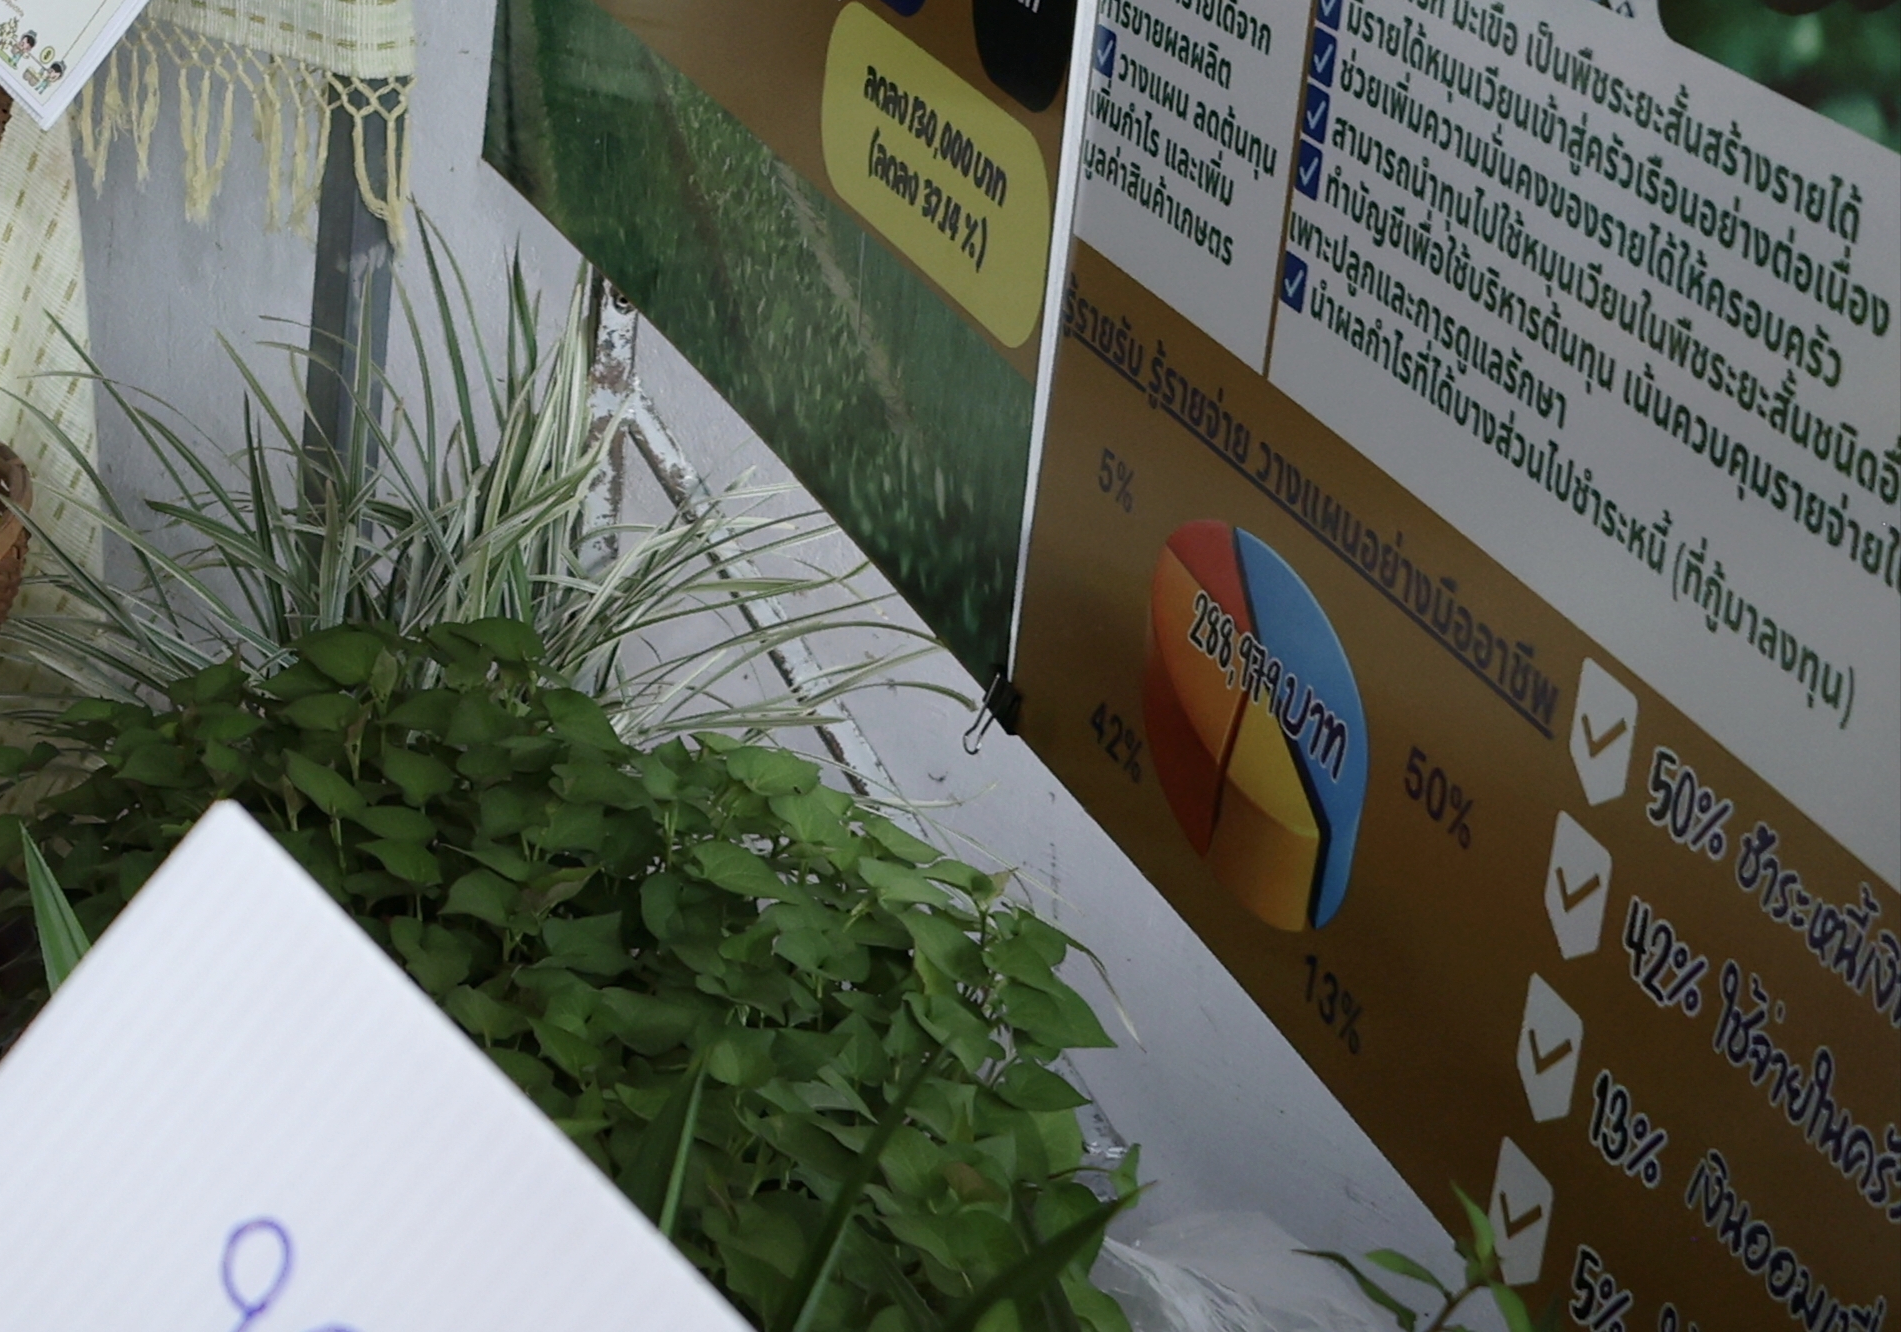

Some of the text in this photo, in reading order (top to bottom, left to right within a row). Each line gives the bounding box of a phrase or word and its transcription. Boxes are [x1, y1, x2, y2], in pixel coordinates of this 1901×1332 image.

[1089, 79, 1235, 208] เพิ่มกำไร และเพิ่ม
[1118, 51, 1277, 180] วางแผน ลดต้นทุน
[973, 148, 1008, 207] บาท
[1083, 137, 1234, 267] มูลค่าสินค้าเกษตร
[1289, 210, 1568, 430] เพาะปลูกและการดูแลรักษา
[1324, 165, 1615, 394] ทำบัญชีเพื่อใช้บริหารต้นทุน
[1097, 446, 1135, 515] 5%
[1309, 278, 1674, 576] นำผลกำไรที่ได้บางส่วนไปชำระหนี้
[1088, 700, 1144, 784] 42%
[1403, 745, 1473, 849] 50%
[1645, 747, 1732, 858] 50%
[1303, 953, 1363, 1056] 13%
[1622, 896, 1709, 1015] 42%
[1589, 1069, 1668, 1188] 13%
